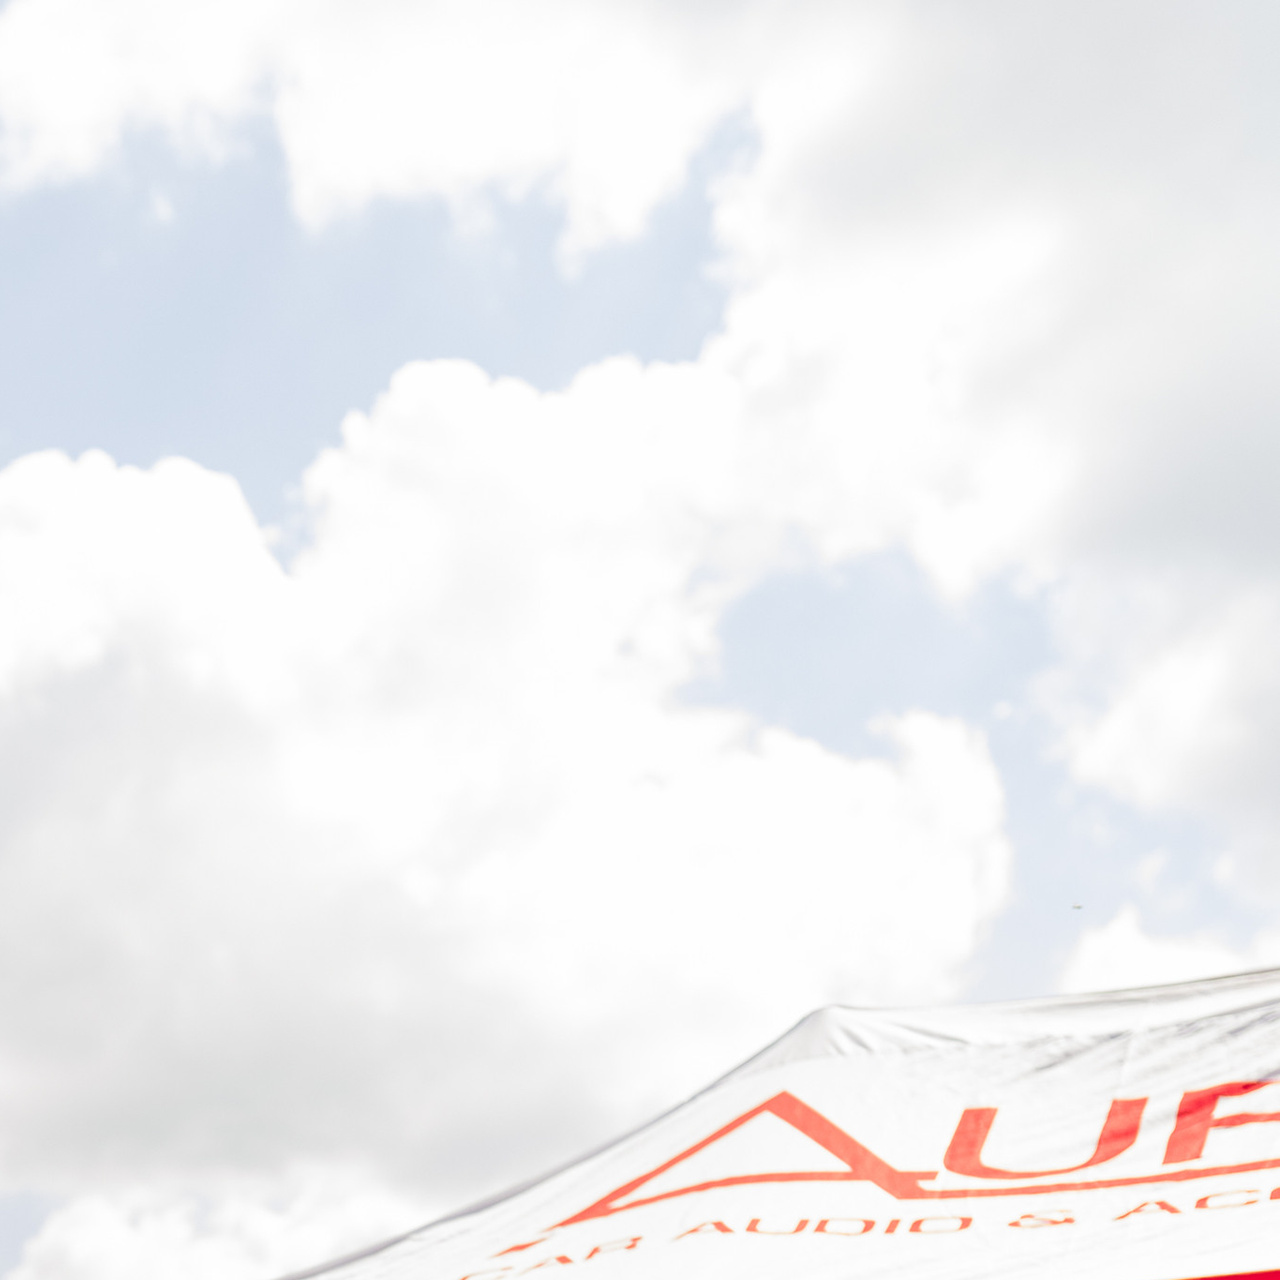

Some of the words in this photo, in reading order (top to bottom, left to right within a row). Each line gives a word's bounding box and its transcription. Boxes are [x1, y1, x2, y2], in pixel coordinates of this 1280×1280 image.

[673, 1216, 973, 1241] AUDIO
[1008, 1211, 1076, 1229] &
[1112, 1188, 1280, 1221] AC
